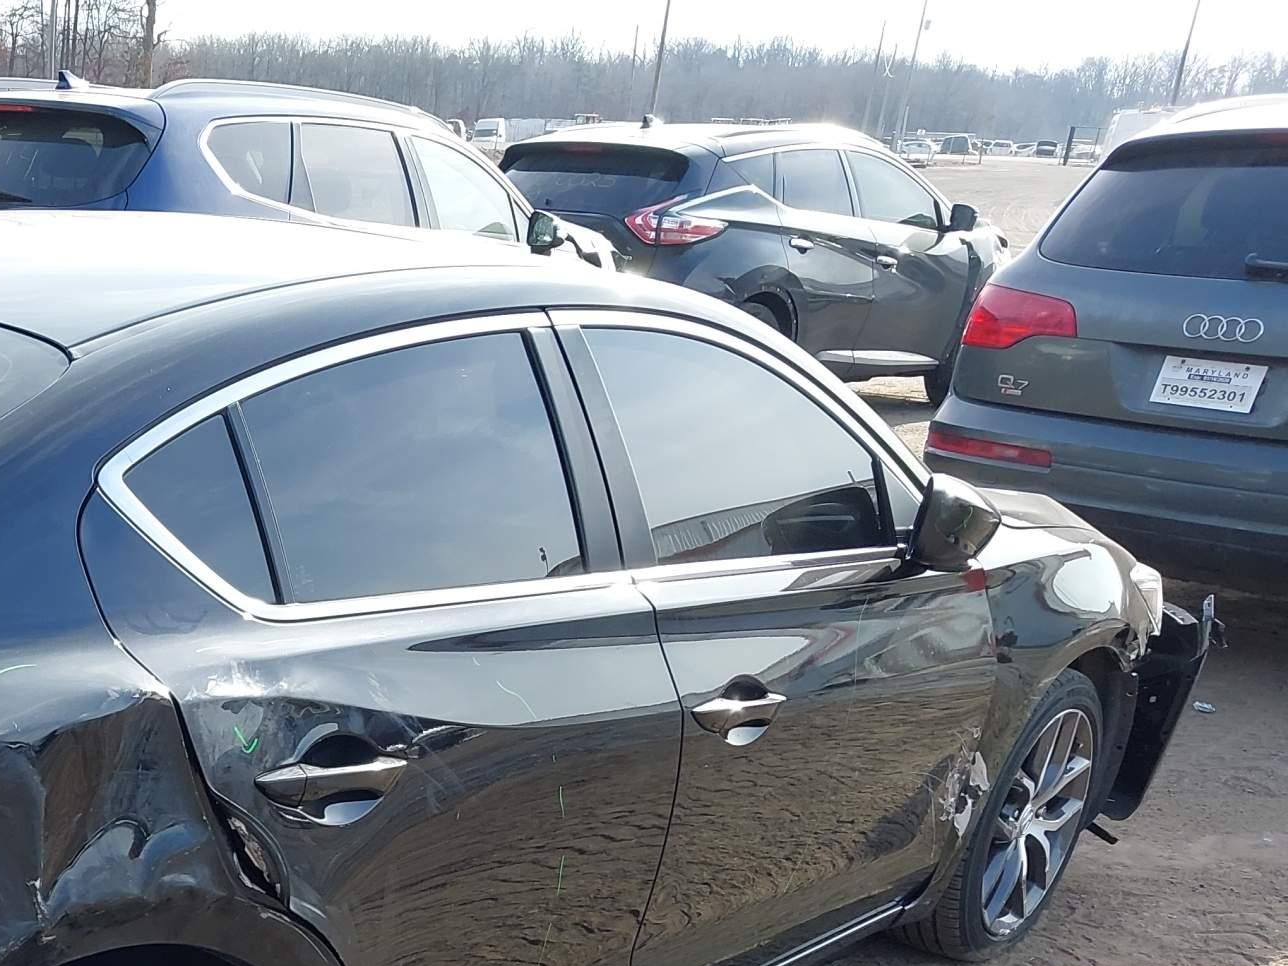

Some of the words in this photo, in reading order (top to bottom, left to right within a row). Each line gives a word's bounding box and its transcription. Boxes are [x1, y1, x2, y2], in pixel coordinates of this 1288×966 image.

[1185, 366, 1249, 380] MARYLAND
[997, 374, 1029, 390] Q7
[1161, 383, 1247, 403] T99552301
